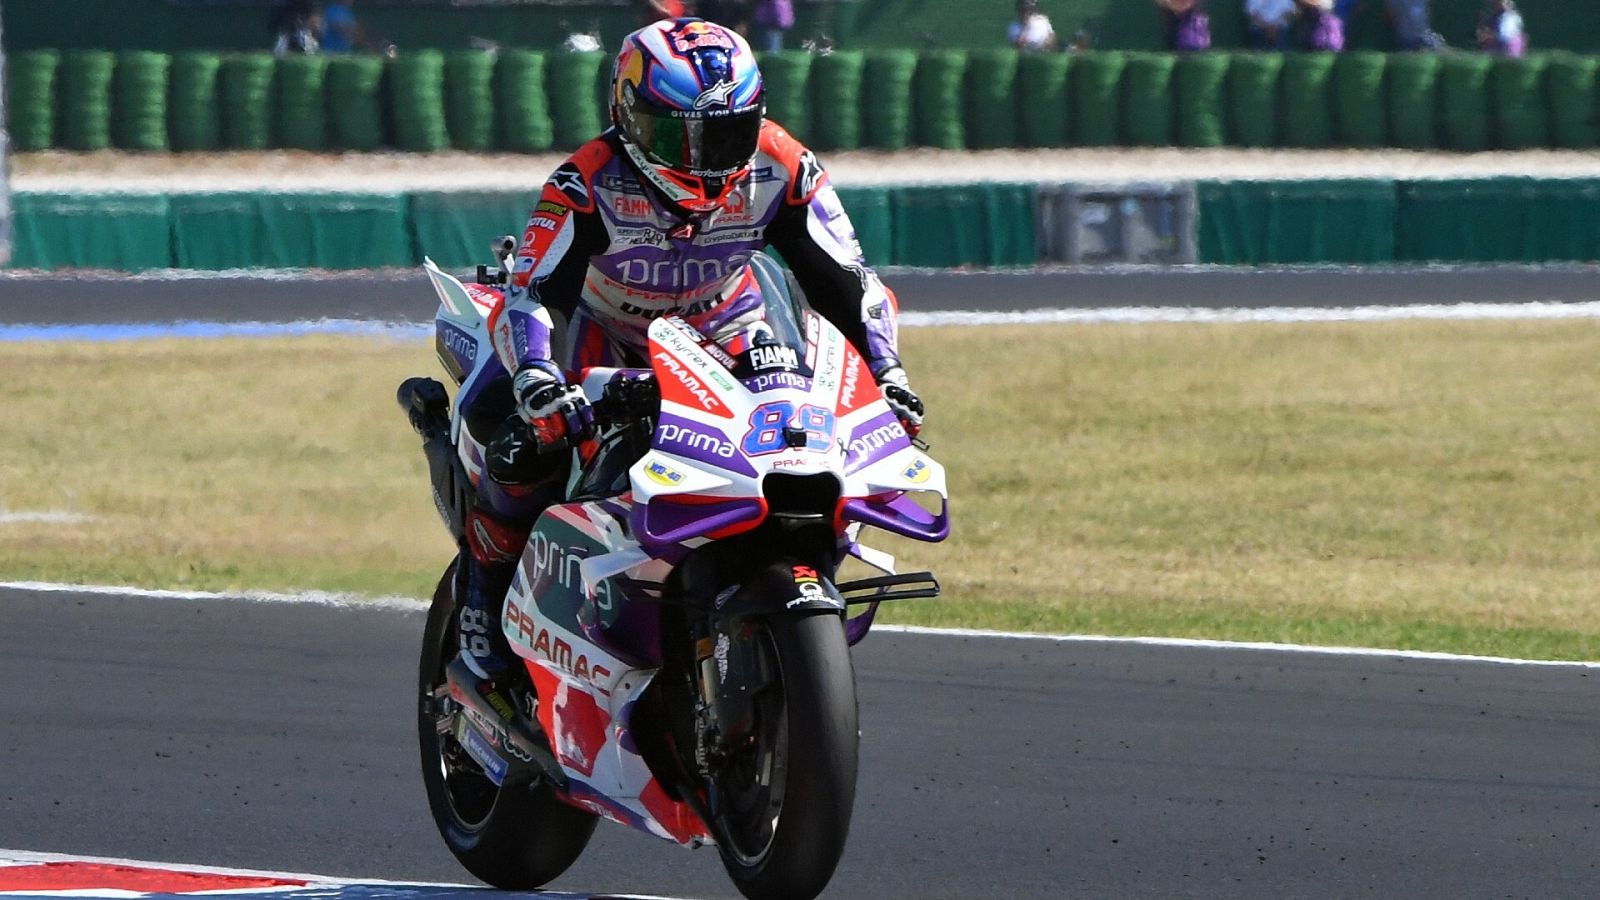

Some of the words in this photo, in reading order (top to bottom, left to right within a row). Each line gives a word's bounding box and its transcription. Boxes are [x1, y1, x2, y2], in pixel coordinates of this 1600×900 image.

[527, 217, 557, 230] OTUL
[616, 255, 747, 287] prima
[445, 329, 477, 360] prima
[704, 343, 738, 369] MOTUL
[750, 346, 798, 369] FIAMM
[654, 352, 719, 410] PRAMAC
[754, 371, 806, 391] prima
[840, 351, 861, 409] PRAMAC
[659, 424, 736, 459] prima
[740, 400, 838, 457] 89
[848, 420, 906, 461] prima
[650, 460, 682, 482] WD-40
[786, 595, 841, 609] PRAMAC
[505, 598, 611, 697] PRAMAC
